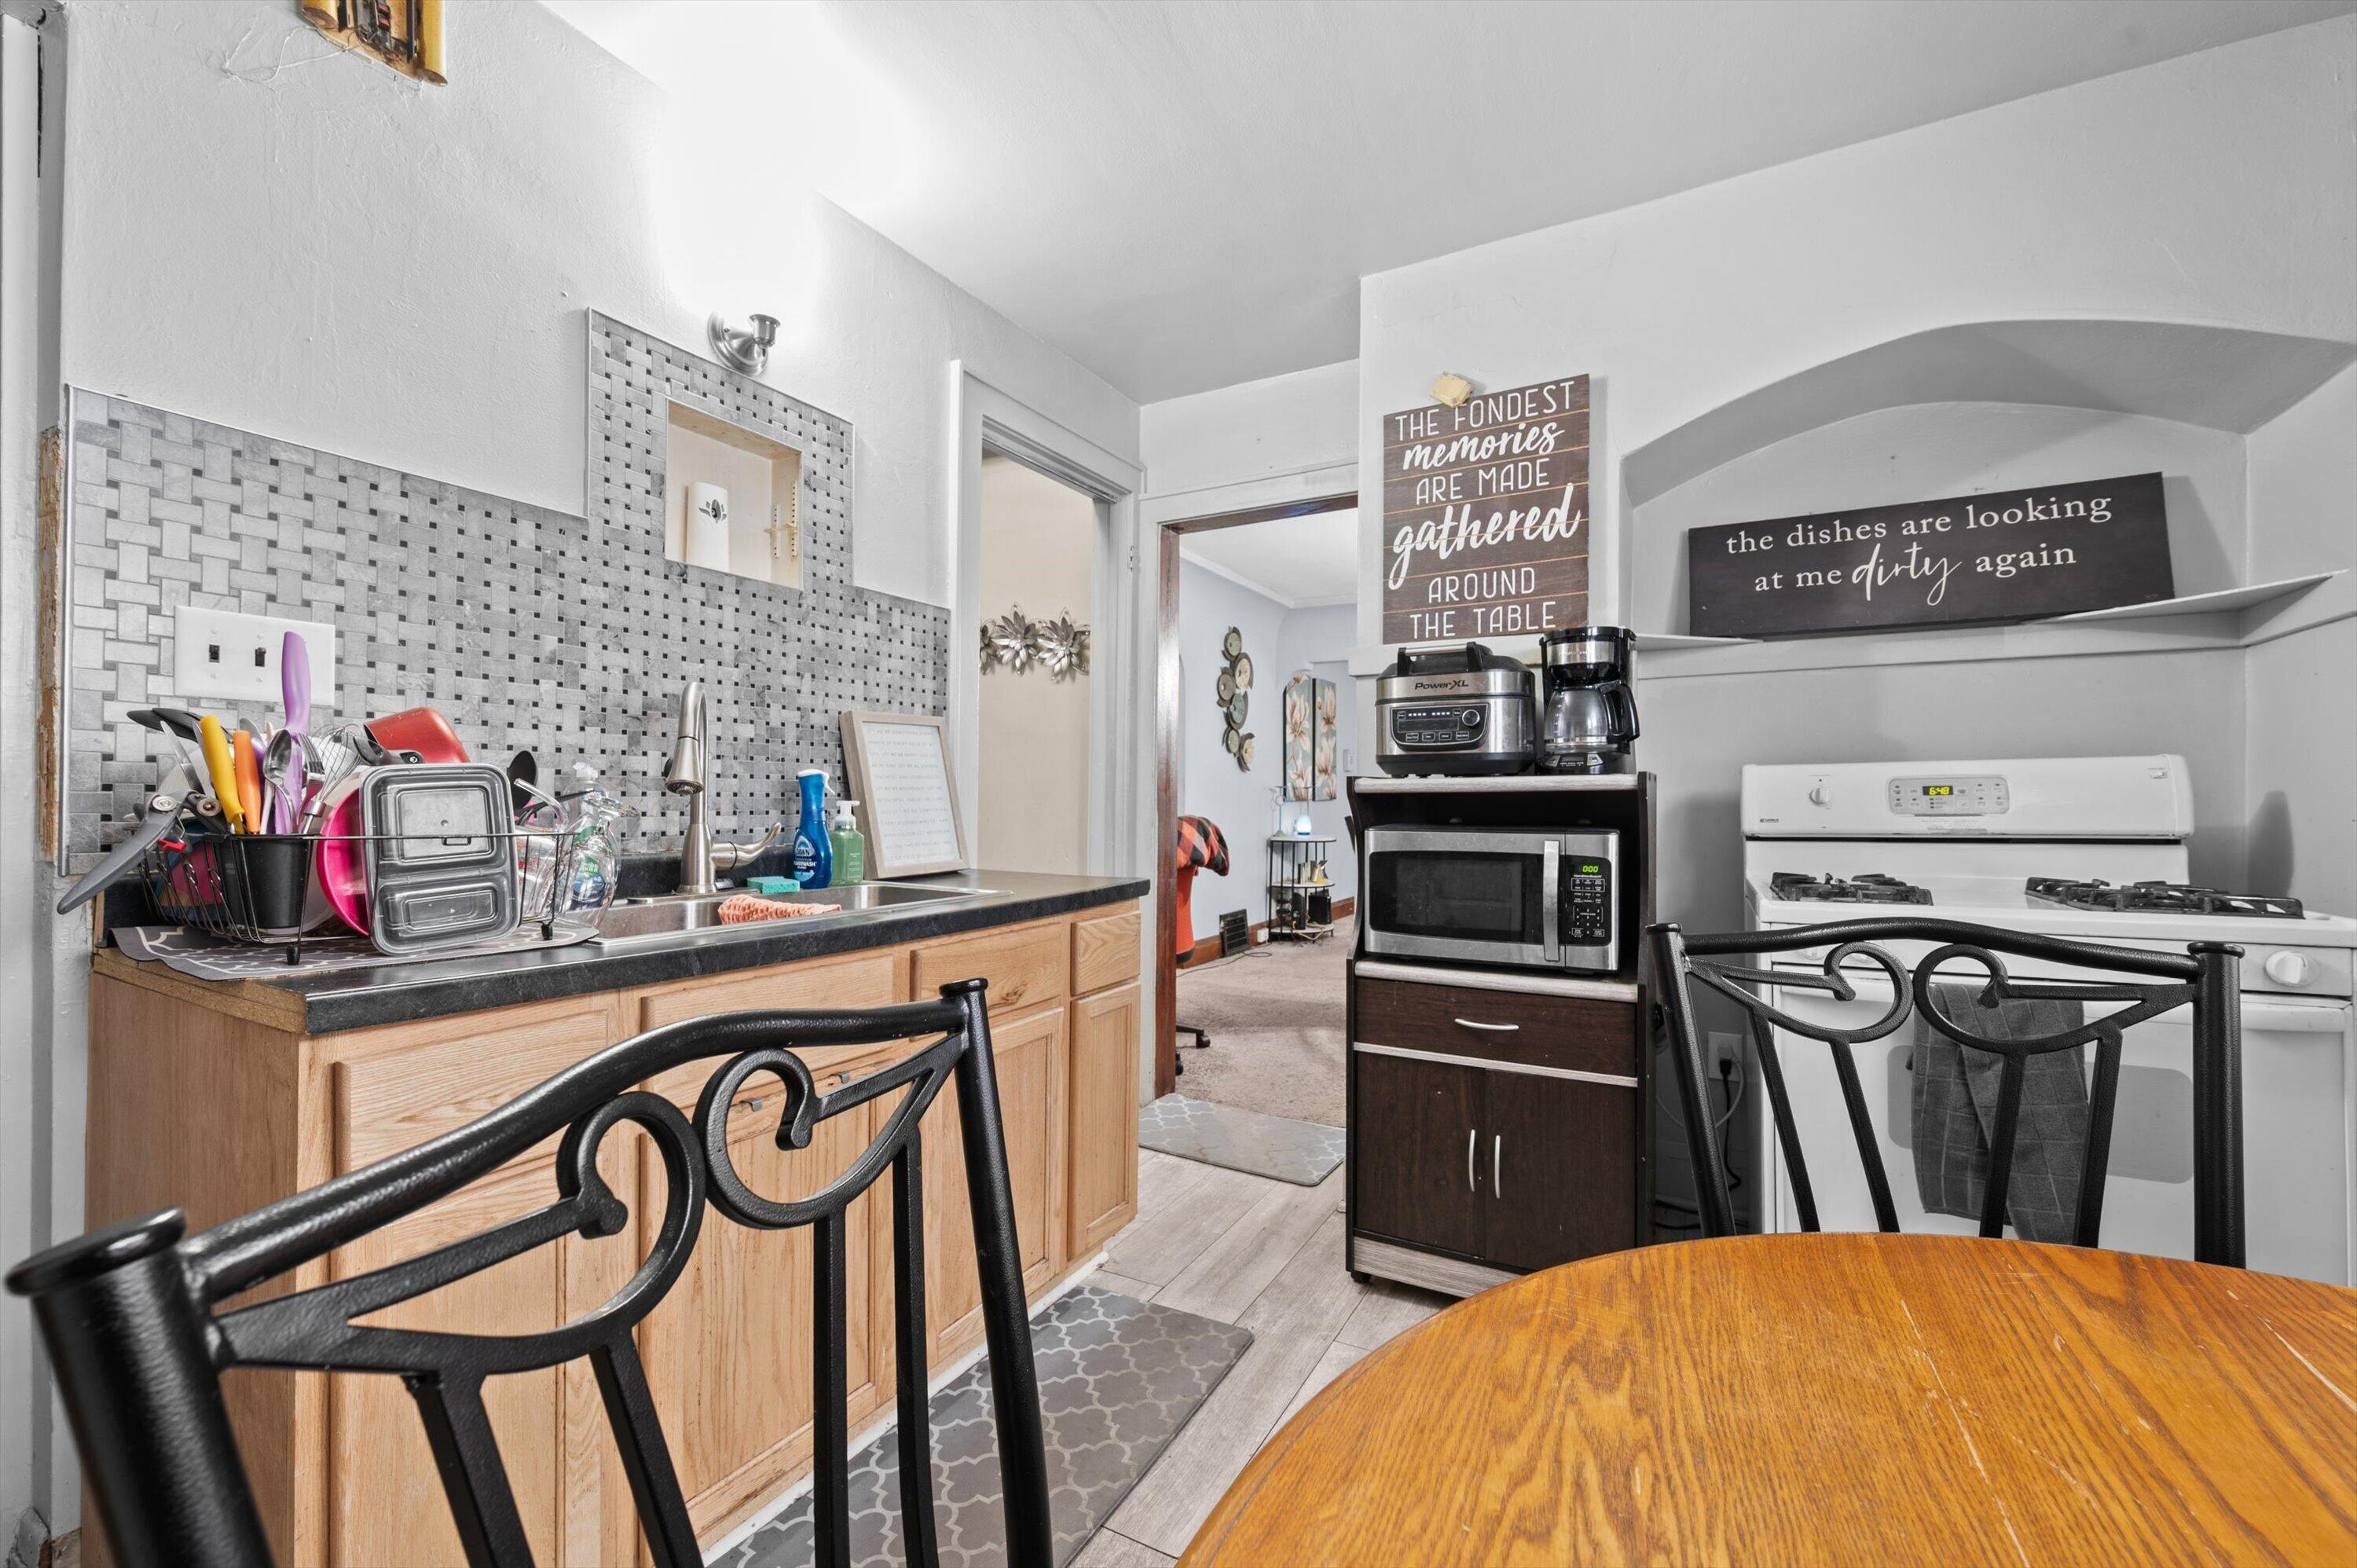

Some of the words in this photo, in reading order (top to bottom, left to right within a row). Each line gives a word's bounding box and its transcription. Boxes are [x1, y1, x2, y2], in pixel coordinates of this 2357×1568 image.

[1395, 409, 1439, 441] THE
[1453, 380, 1574, 431] FONDEST
[1403, 422, 1565, 471] memories
[1417, 472, 1463, 505] ARE
[1478, 458, 1550, 496] MADE
[1388, 482, 1582, 591] gathered
[1727, 531, 1773, 553] the
[1787, 519, 1886, 548] dishes
[1902, 517, 1951, 535] are
[1966, 496, 2113, 529] looking
[1429, 566, 1534, 603] AROUND
[1755, 573, 1783, 591] at
[1797, 570, 1842, 587] me
[1852, 542, 1962, 606] dirty
[1976, 544, 2076, 577] again
[1410, 611, 1455, 639] THE
[1473, 602, 1556, 633] TABLE
[1415, 680, 1469, 691] PowerXL
